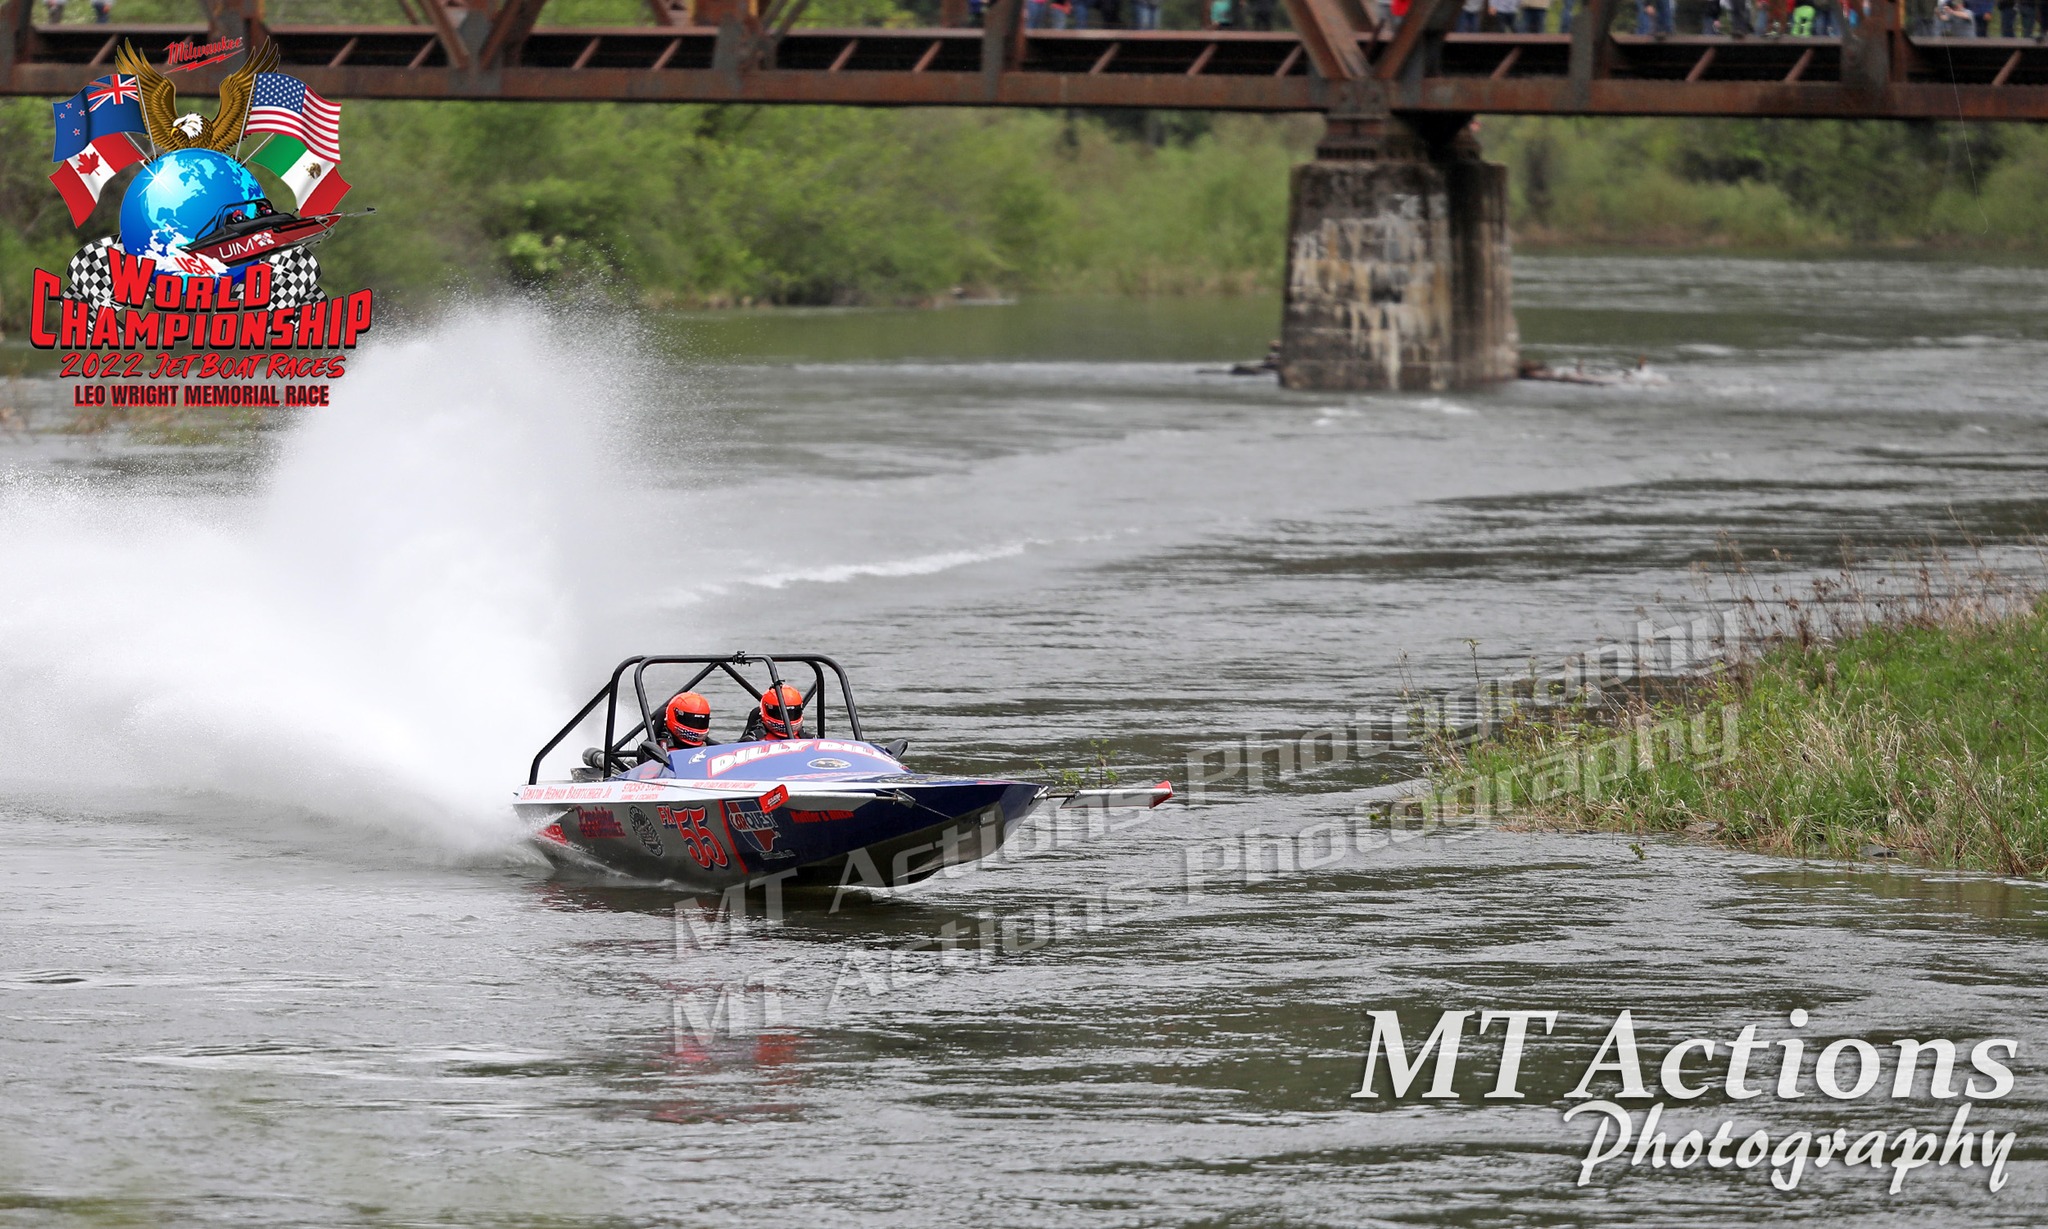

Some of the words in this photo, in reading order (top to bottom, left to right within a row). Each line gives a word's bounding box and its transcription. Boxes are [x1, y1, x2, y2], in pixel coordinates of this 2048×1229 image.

[707, 740, 810, 778] DILLY
[656, 805, 675, 828] FX
[672, 804, 729, 869] 55
[729, 810, 779, 832] CARQUEST
